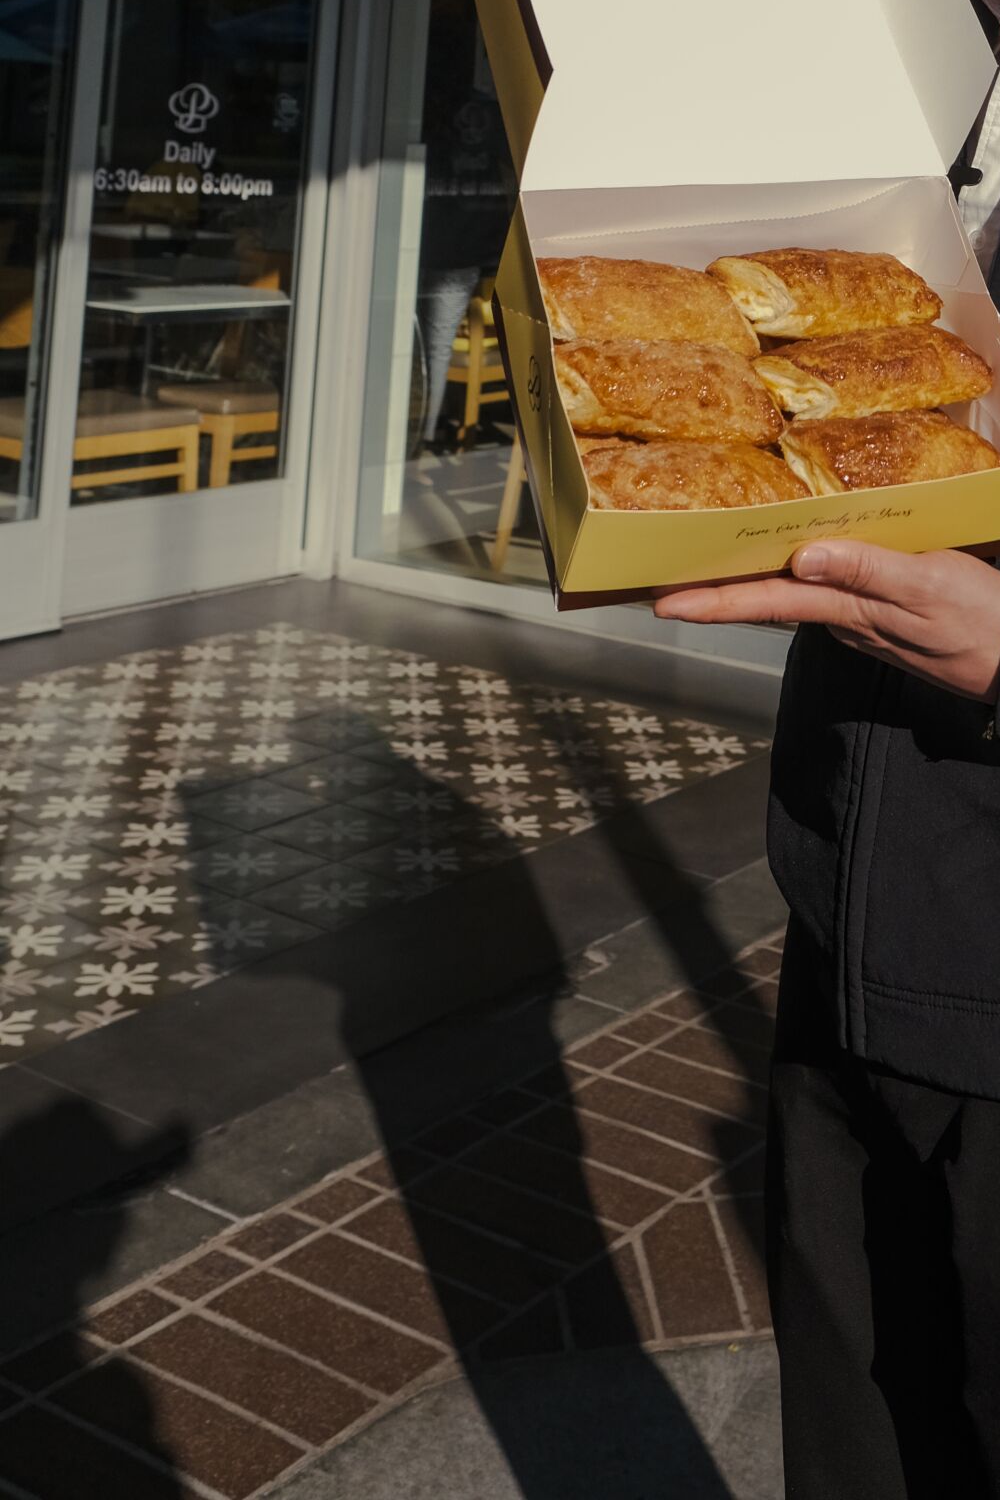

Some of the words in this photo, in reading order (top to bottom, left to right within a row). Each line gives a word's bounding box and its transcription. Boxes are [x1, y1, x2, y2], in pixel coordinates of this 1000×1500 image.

[164, 140, 215, 169] Daily
[95, 168, 171, 193] 6:30am
[176, 172, 198, 193] to
[736, 527, 769, 539] From
[776, 522, 800, 533] Our
[807, 512, 850, 529] Family
[879, 507, 912, 518] Yours
